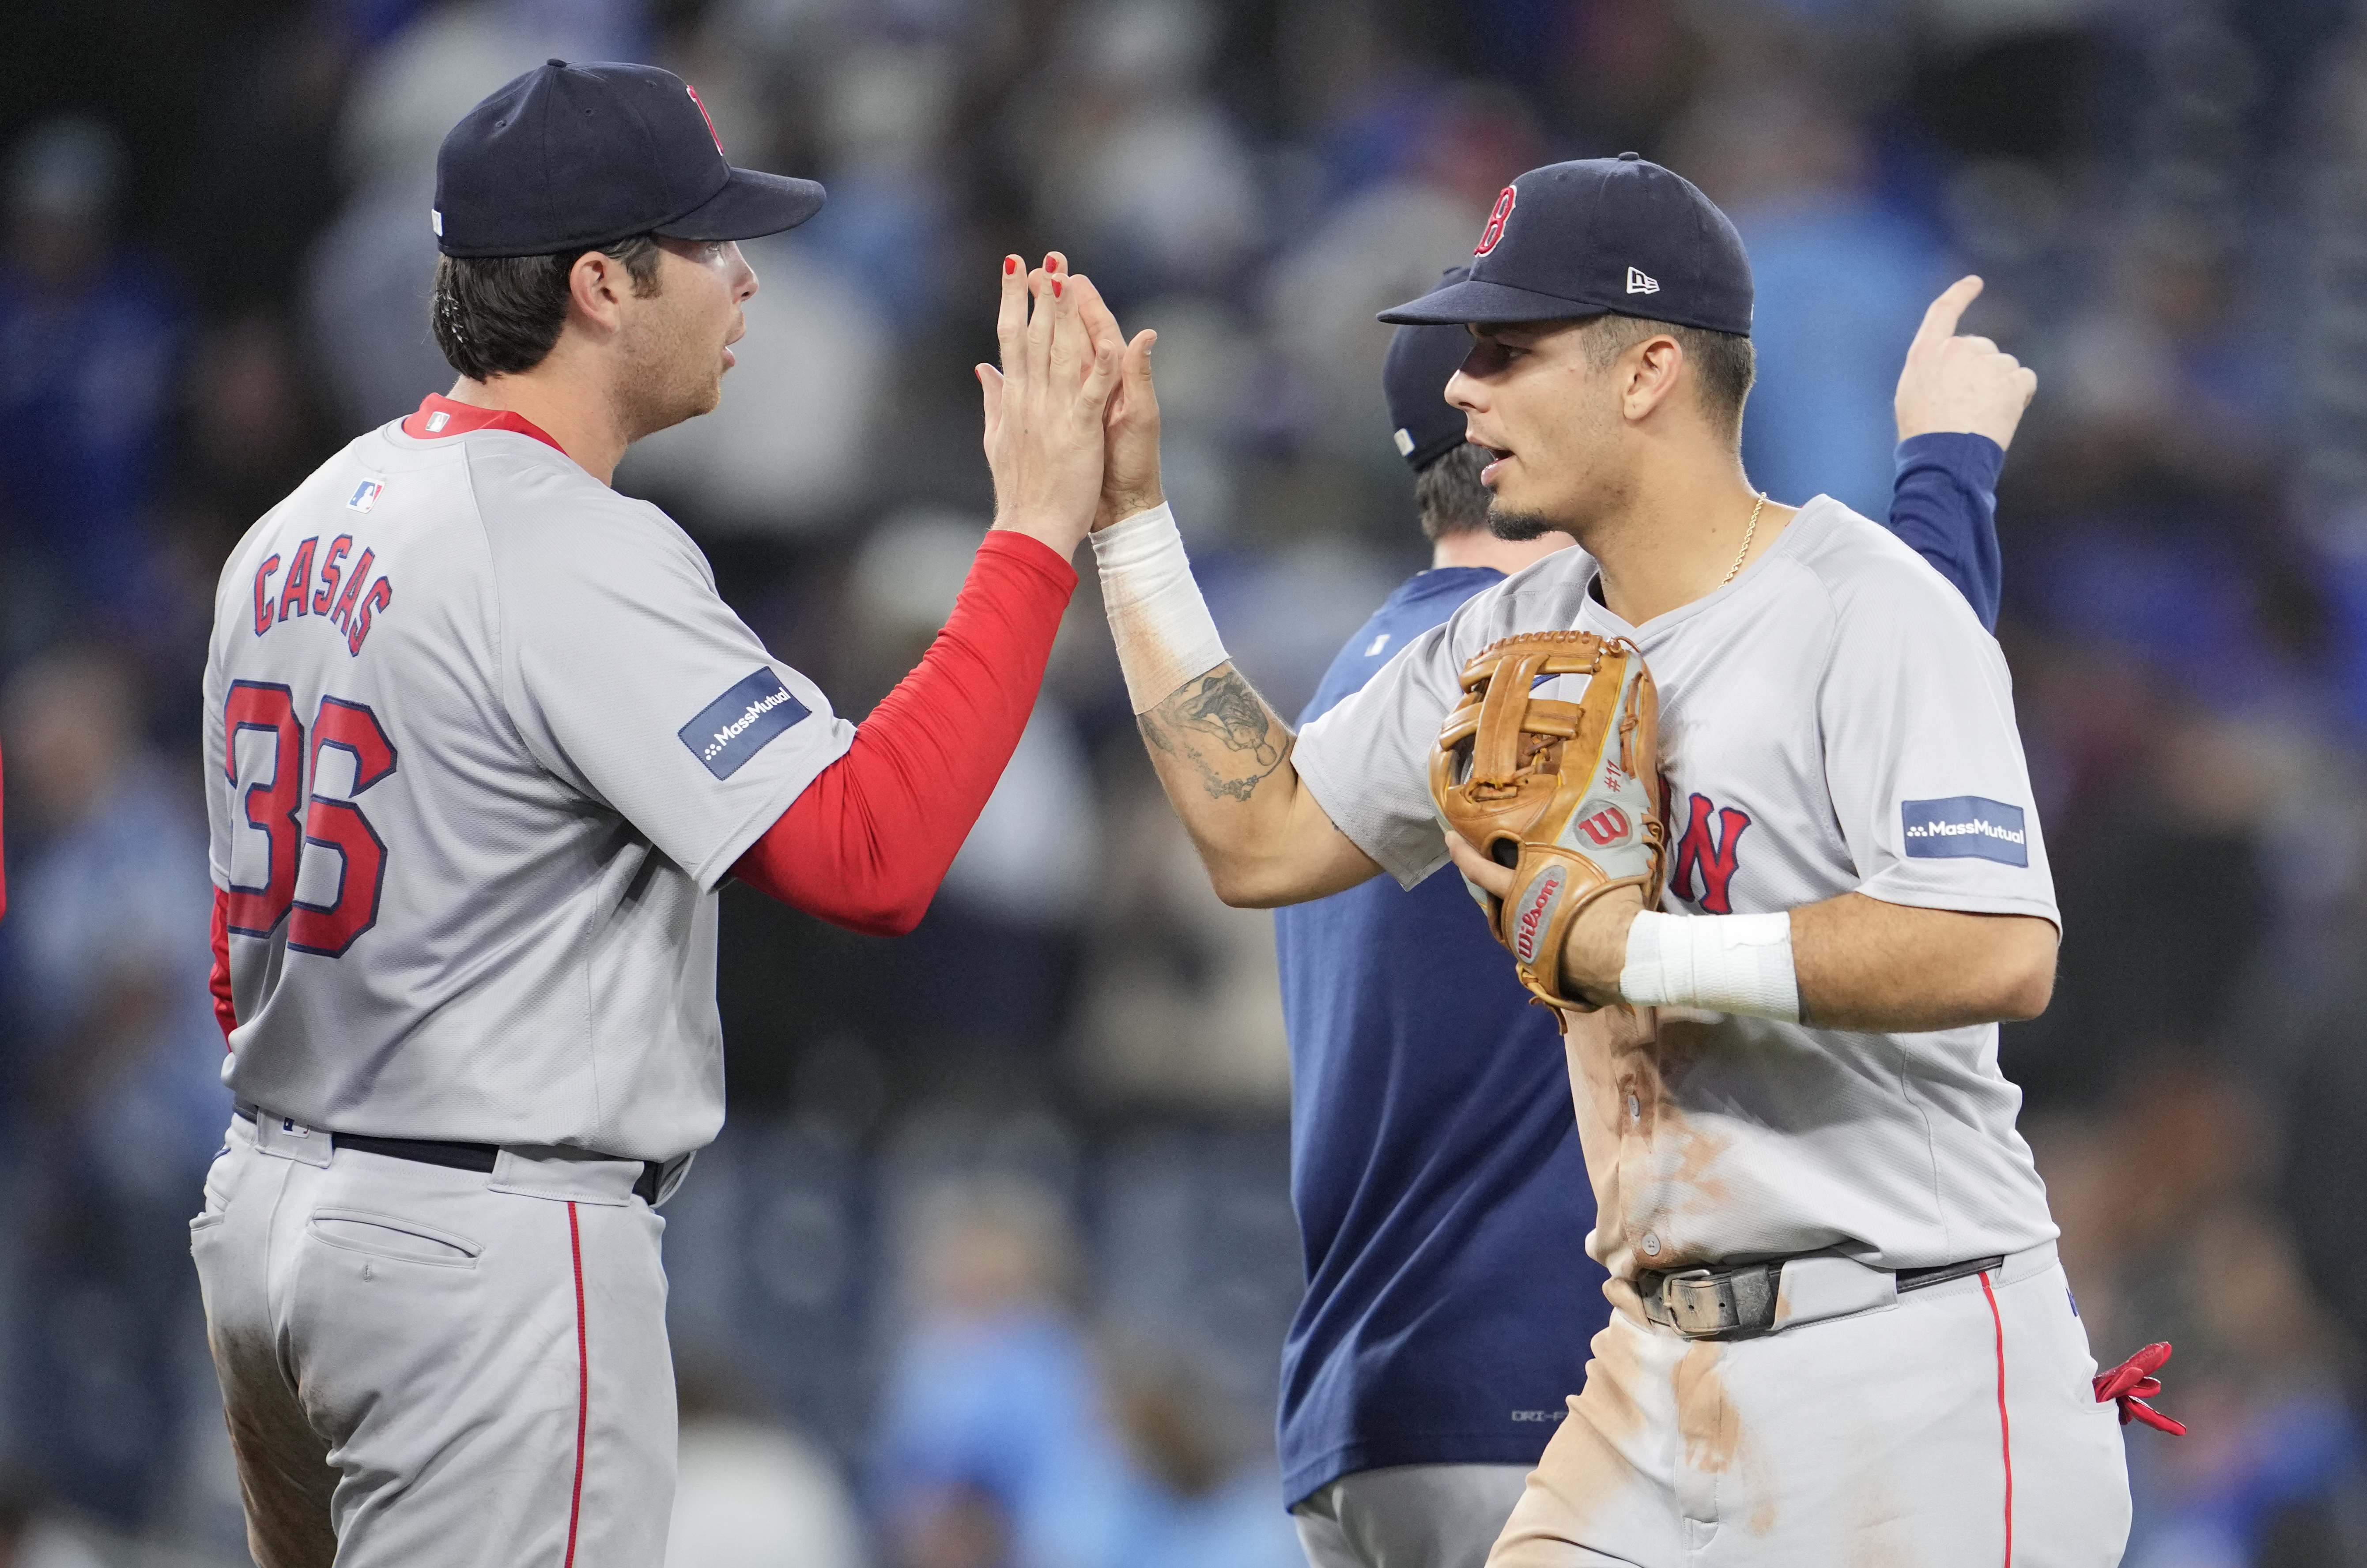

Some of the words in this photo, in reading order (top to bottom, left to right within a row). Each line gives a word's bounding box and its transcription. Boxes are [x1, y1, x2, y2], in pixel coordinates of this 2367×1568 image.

[1473, 185, 1517, 257] B
[254, 533, 393, 658] CASAS
[713, 686, 791, 746] MassMutual
[1604, 759, 1621, 792] #11
[224, 679, 397, 959] 36
[1578, 807, 1629, 845] W
[1928, 818, 2024, 845] MassMutual
[1518, 879, 1559, 959] Wilson
